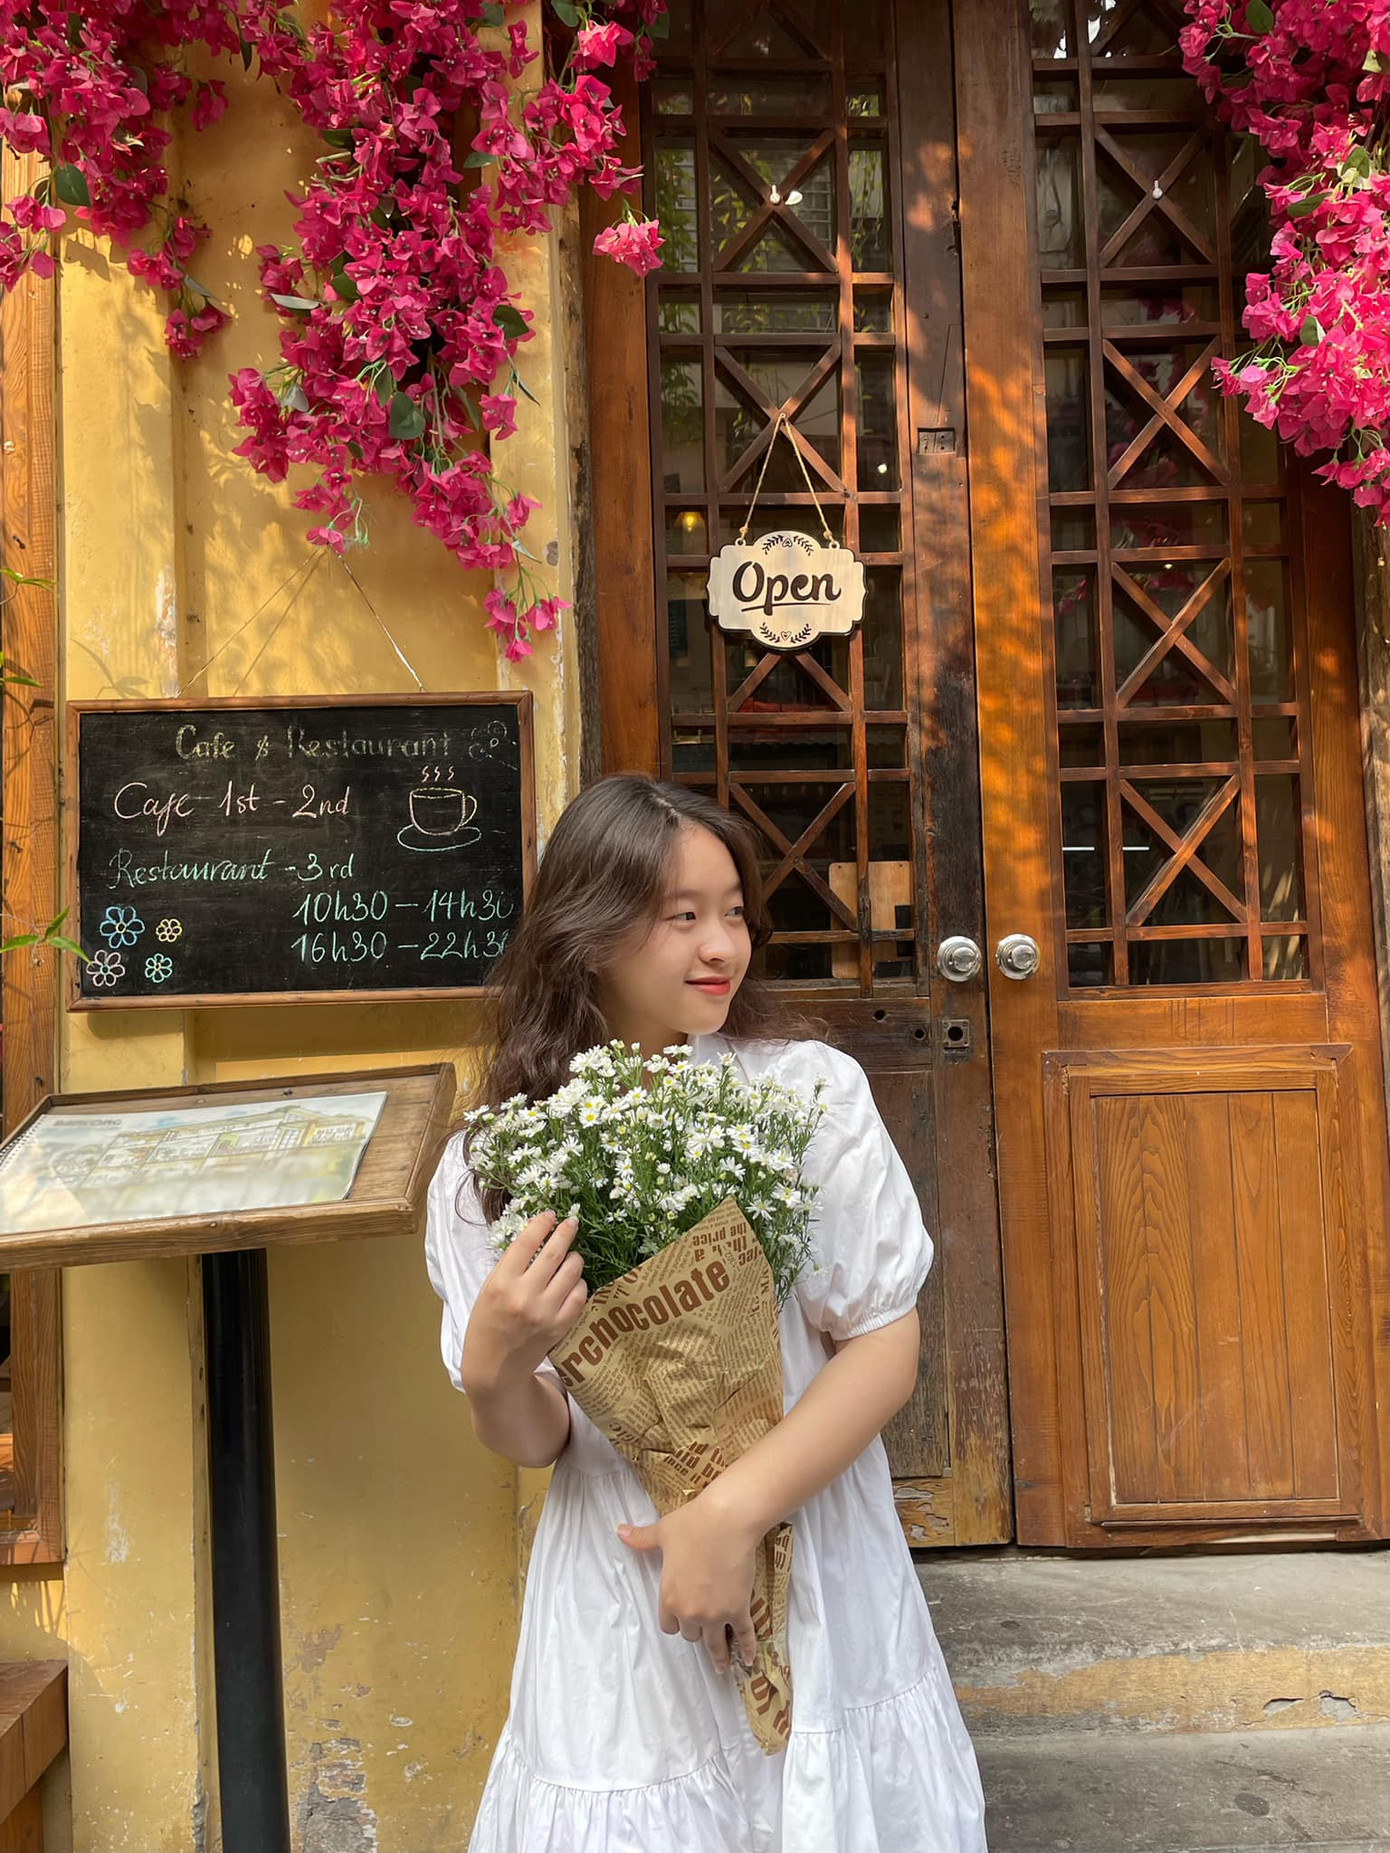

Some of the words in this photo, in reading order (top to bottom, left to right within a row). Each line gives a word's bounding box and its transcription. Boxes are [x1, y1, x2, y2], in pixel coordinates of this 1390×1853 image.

[732, 560, 842, 616] Open
[175, 725, 235, 760] Cafe
[286, 725, 451, 759] Restaurant
[114, 782, 194, 837] Cafe
[218, 780, 261, 816] 1st
[292, 784, 350, 818] 2nd
[106, 848, 275, 890] Restaurant
[292, 889, 388, 926] 10h30
[290, 931, 388, 963] 16h30
